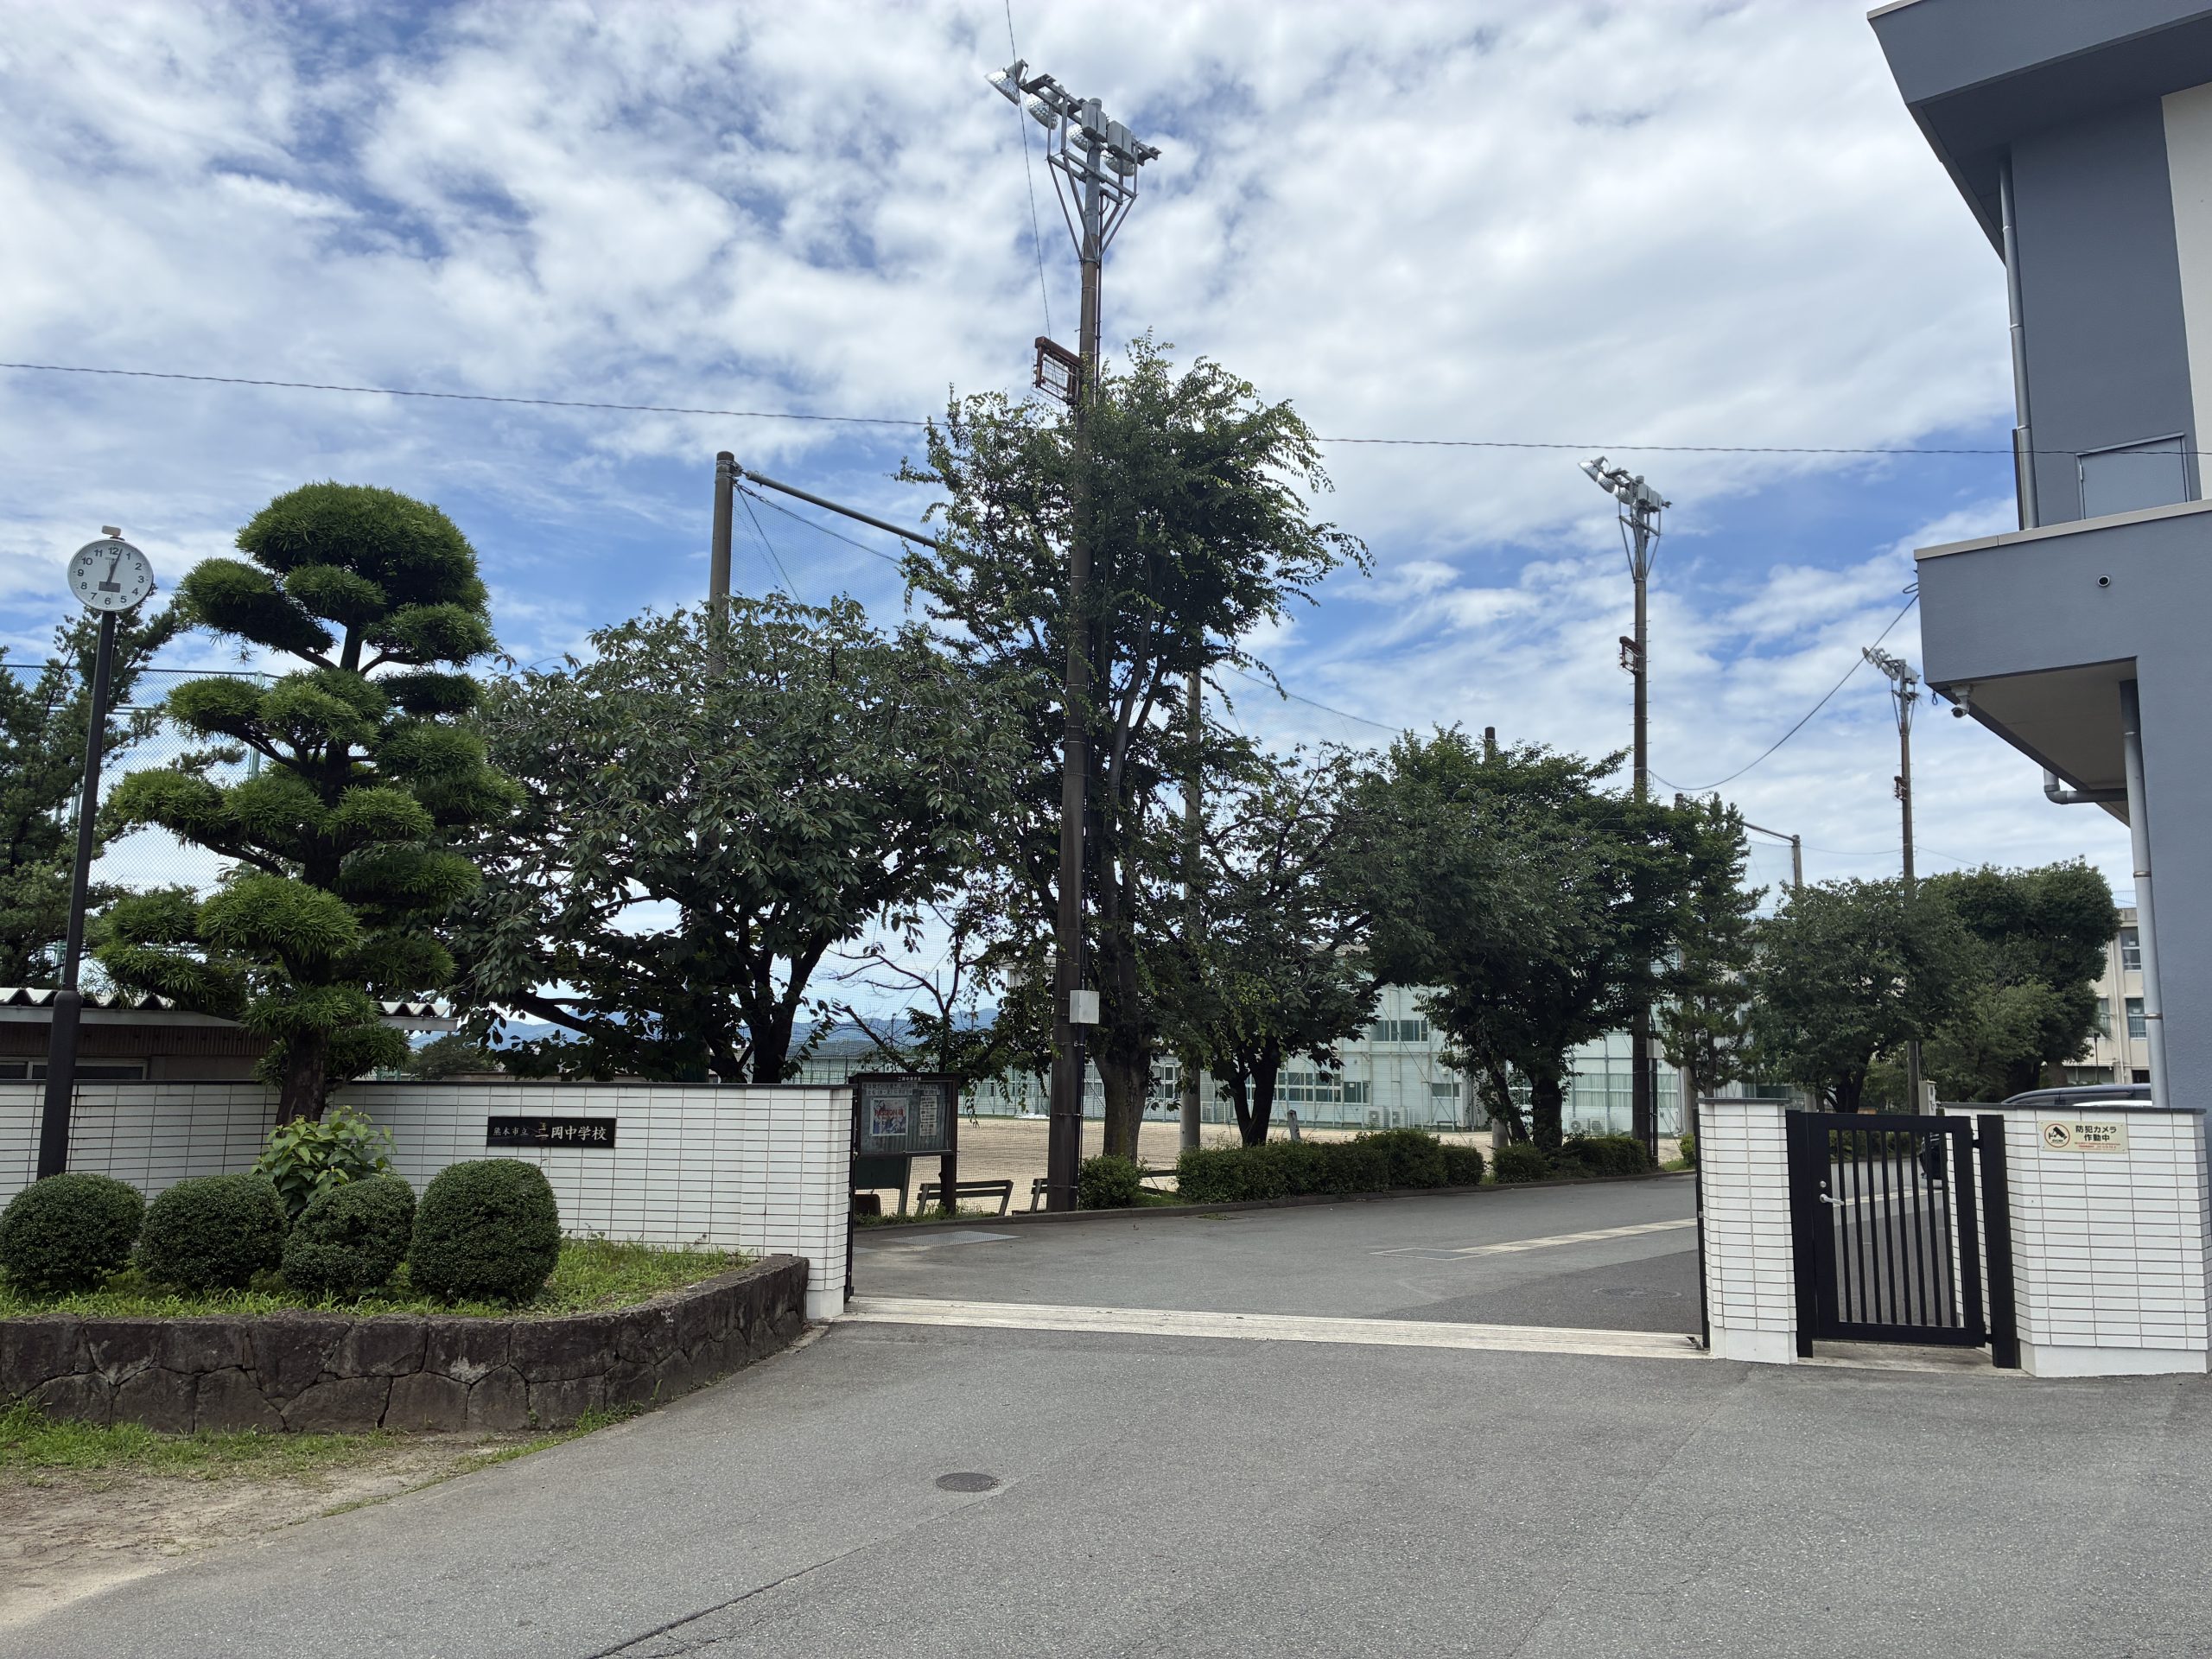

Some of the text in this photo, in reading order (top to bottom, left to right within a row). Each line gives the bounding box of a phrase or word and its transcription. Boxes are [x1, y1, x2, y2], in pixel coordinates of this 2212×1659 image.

[108, 547, 119, 556] 12
[81, 557, 93, 566] 10
[80, 582, 87, 590] 8
[493, 1126, 529, 1136] 熊本市立
[2075, 1125, 2117, 1134] 防犯カメラ
